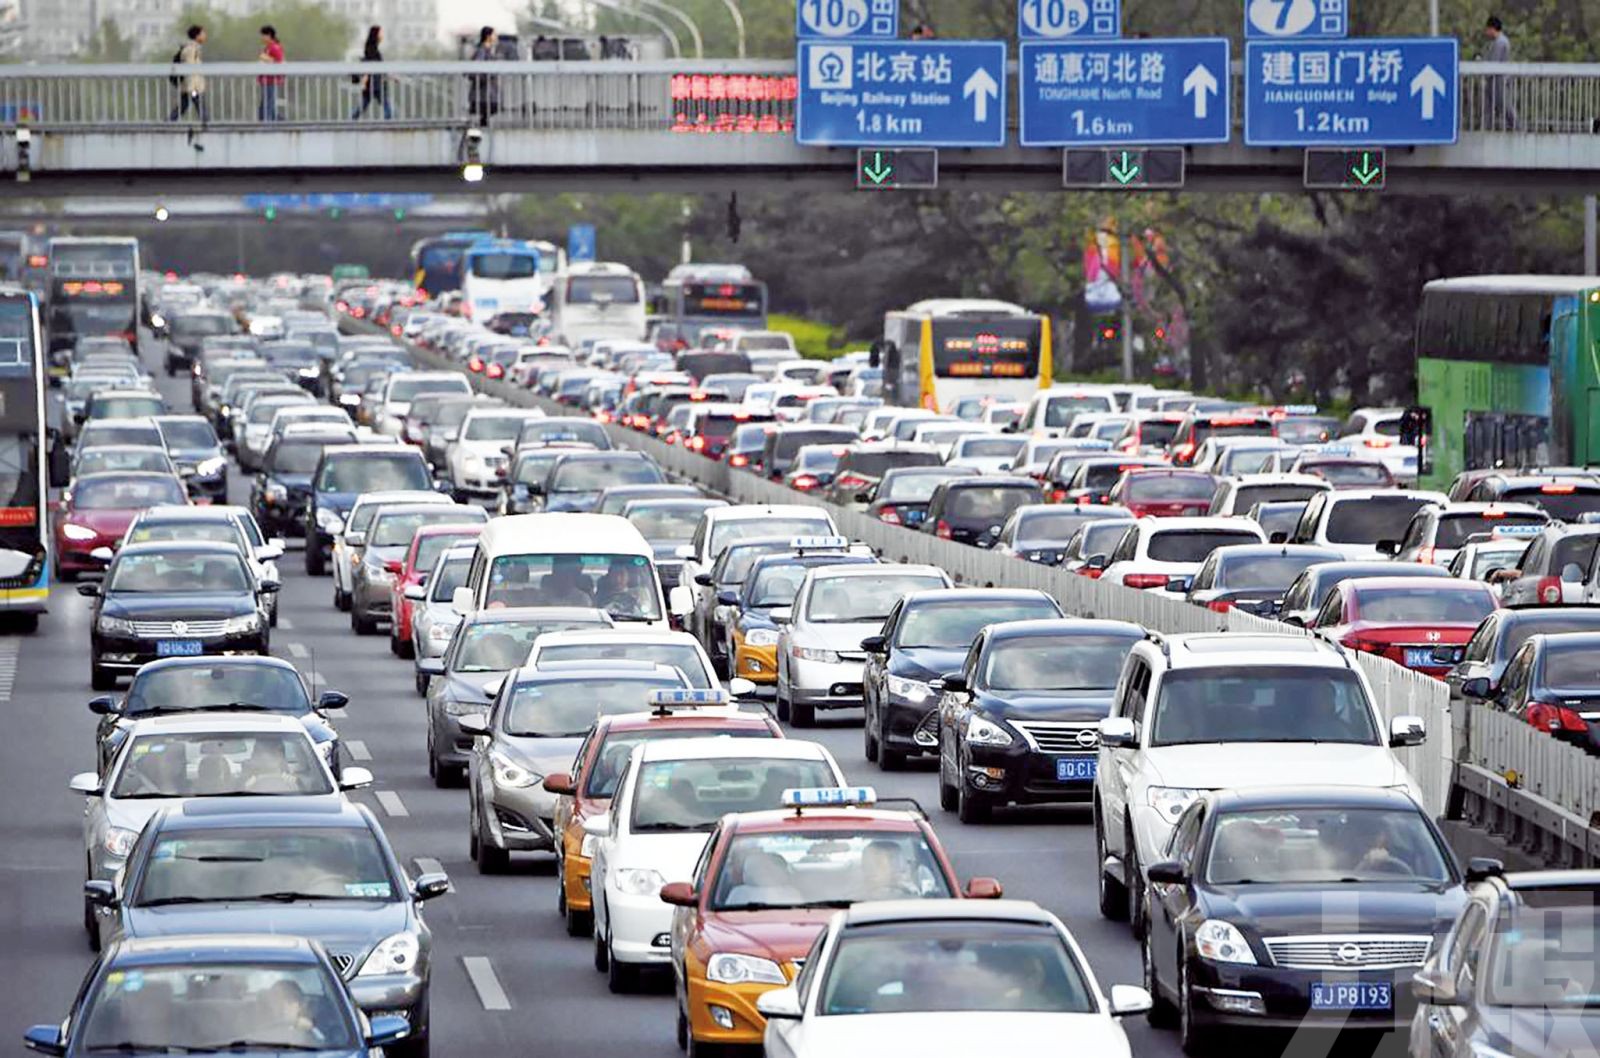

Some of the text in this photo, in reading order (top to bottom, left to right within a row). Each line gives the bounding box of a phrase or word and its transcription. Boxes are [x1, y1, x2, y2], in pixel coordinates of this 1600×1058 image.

[809, 0, 860, 27] 10D
[1030, 0, 1080, 27] 10B
[1270, 0, 1294, 29] 7
[857, 51, 952, 84] 北京站
[1034, 52, 1165, 83] 通惠河北路
[1261, 50, 1402, 85] 建国门桥
[820, 91, 950, 108] Beijing Railway Station
[1136, 87, 1161, 100] Road
[1264, 90, 1355, 103] JIANGUOMEN
